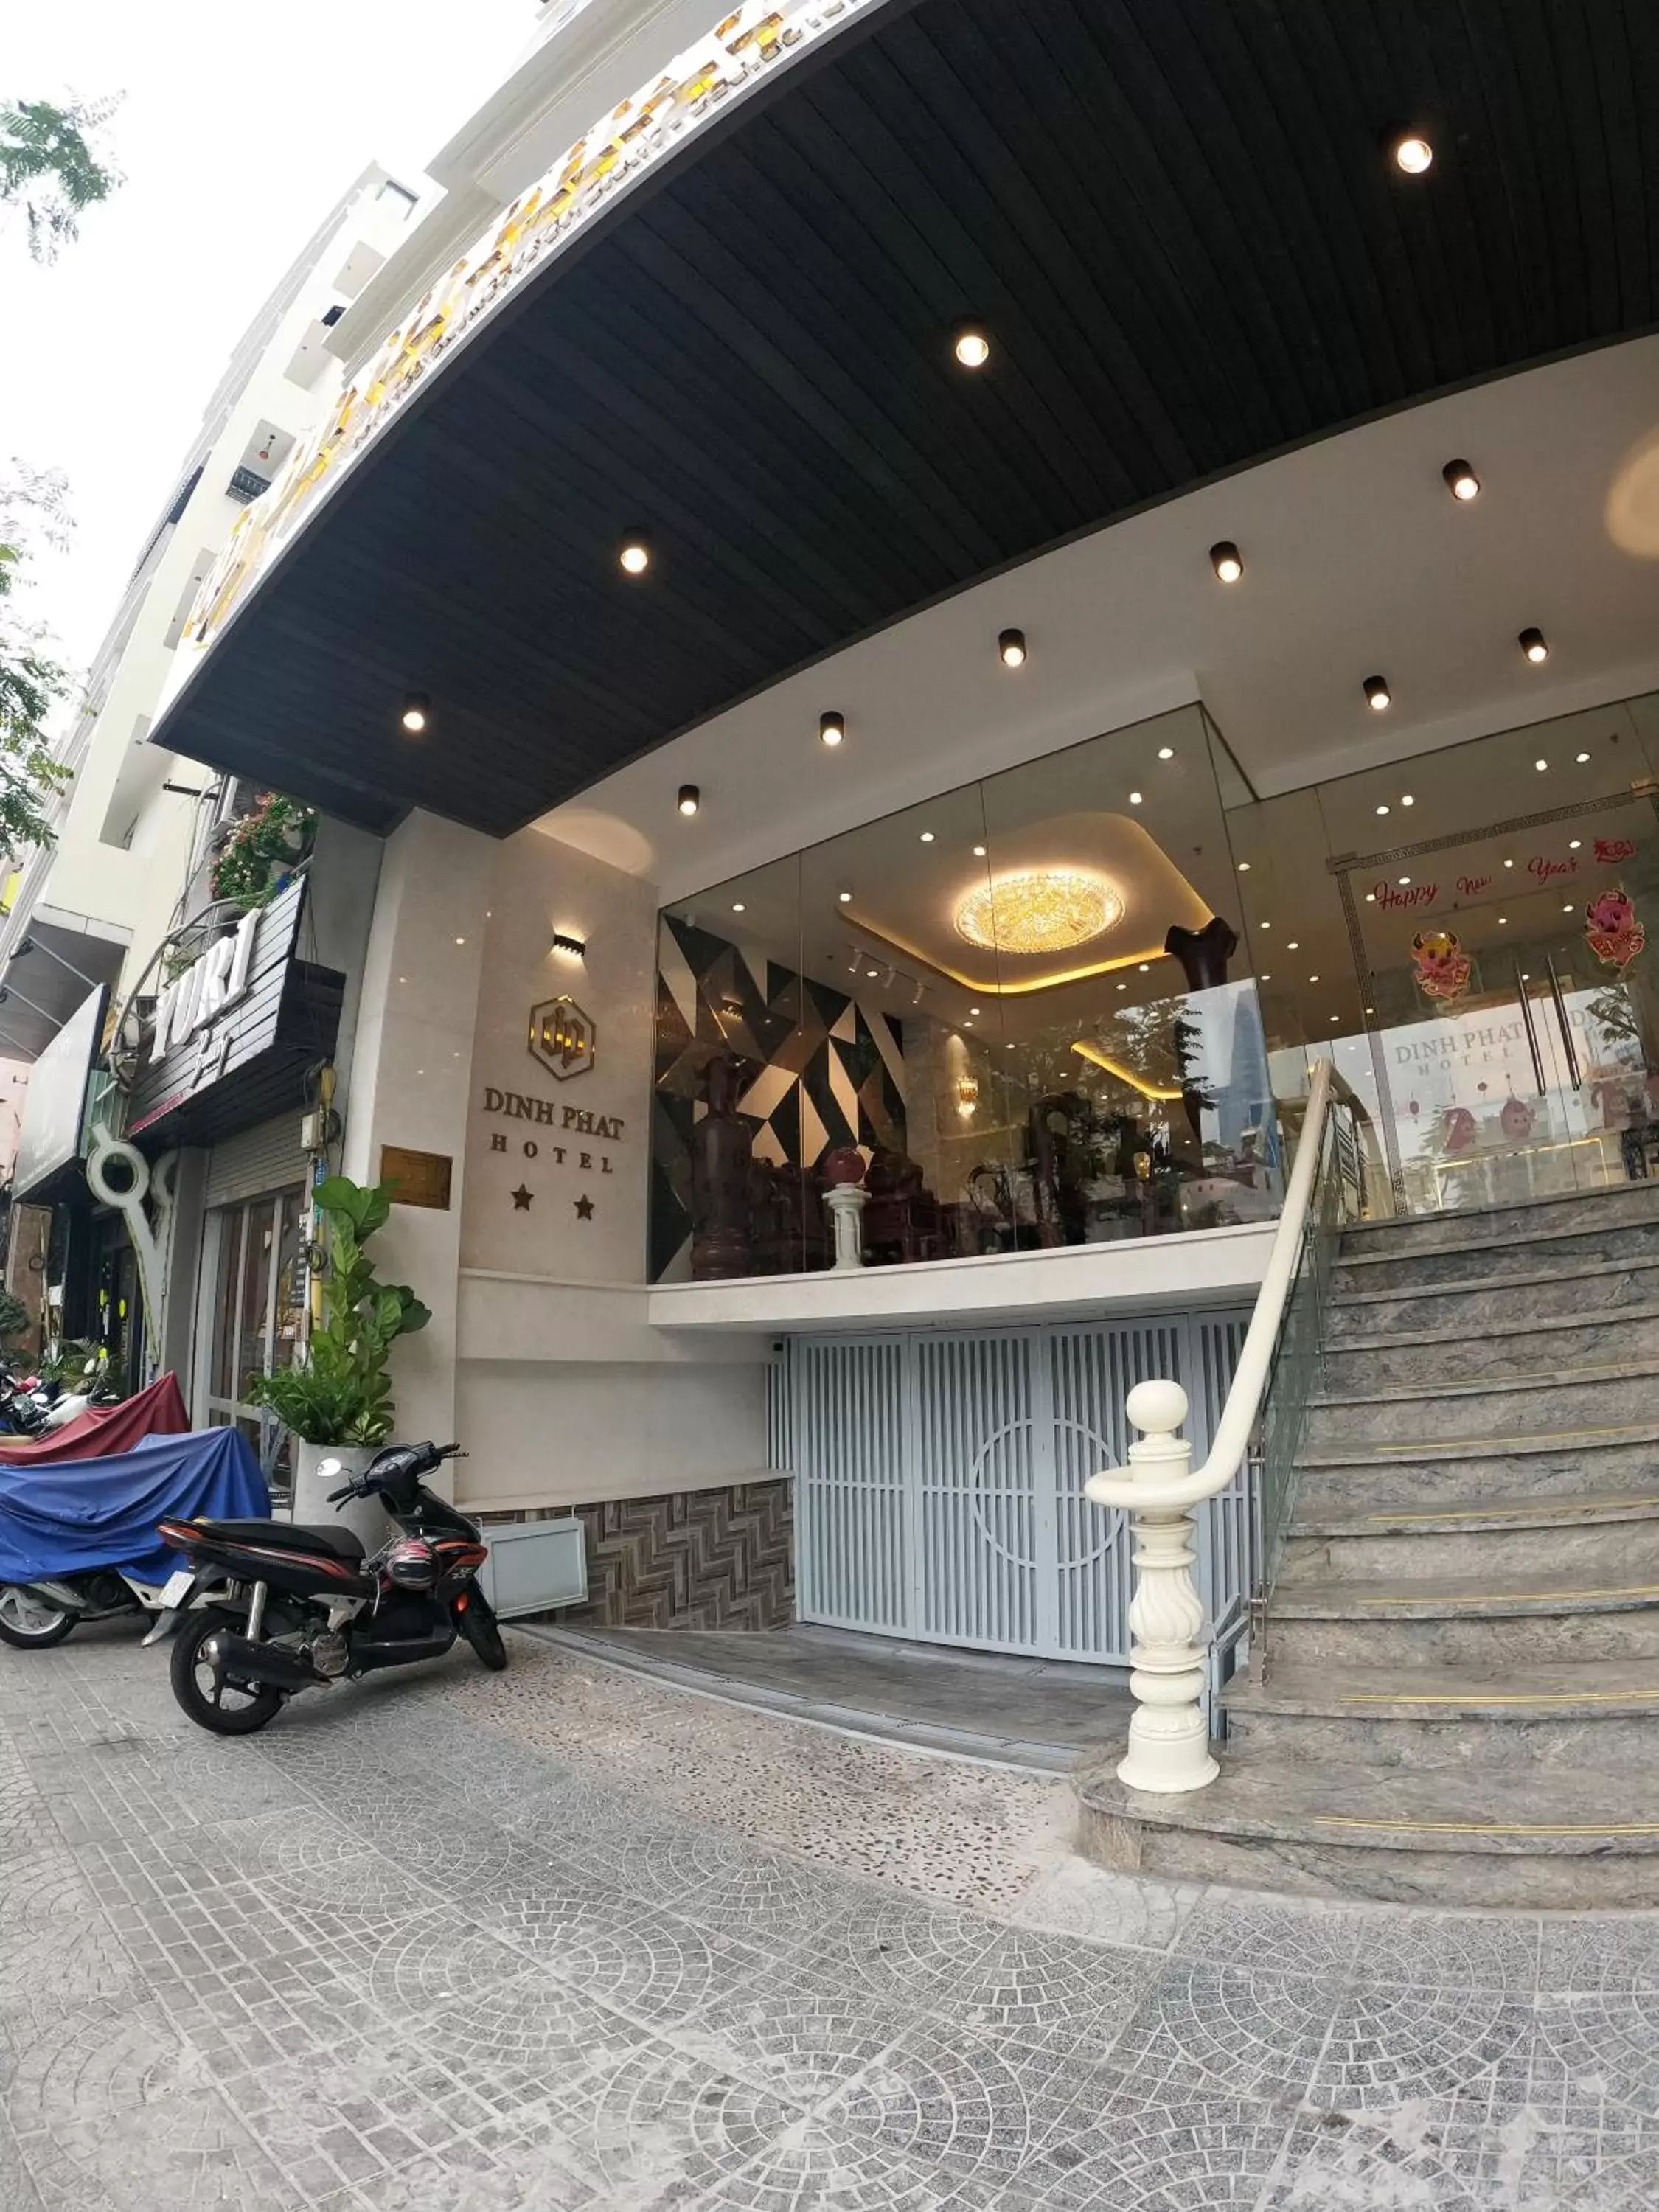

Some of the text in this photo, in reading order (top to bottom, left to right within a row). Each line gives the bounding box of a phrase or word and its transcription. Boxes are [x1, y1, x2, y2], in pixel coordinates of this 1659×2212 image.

[1374, 856, 1580, 910] Happy New Year
[1394, 1020, 1523, 1064] DINH PHAT
[1417, 1046, 1514, 1077] HOTEL
[484, 1087, 625, 1141] DINH PHAT
[490, 1133, 613, 1174] HOTEL
